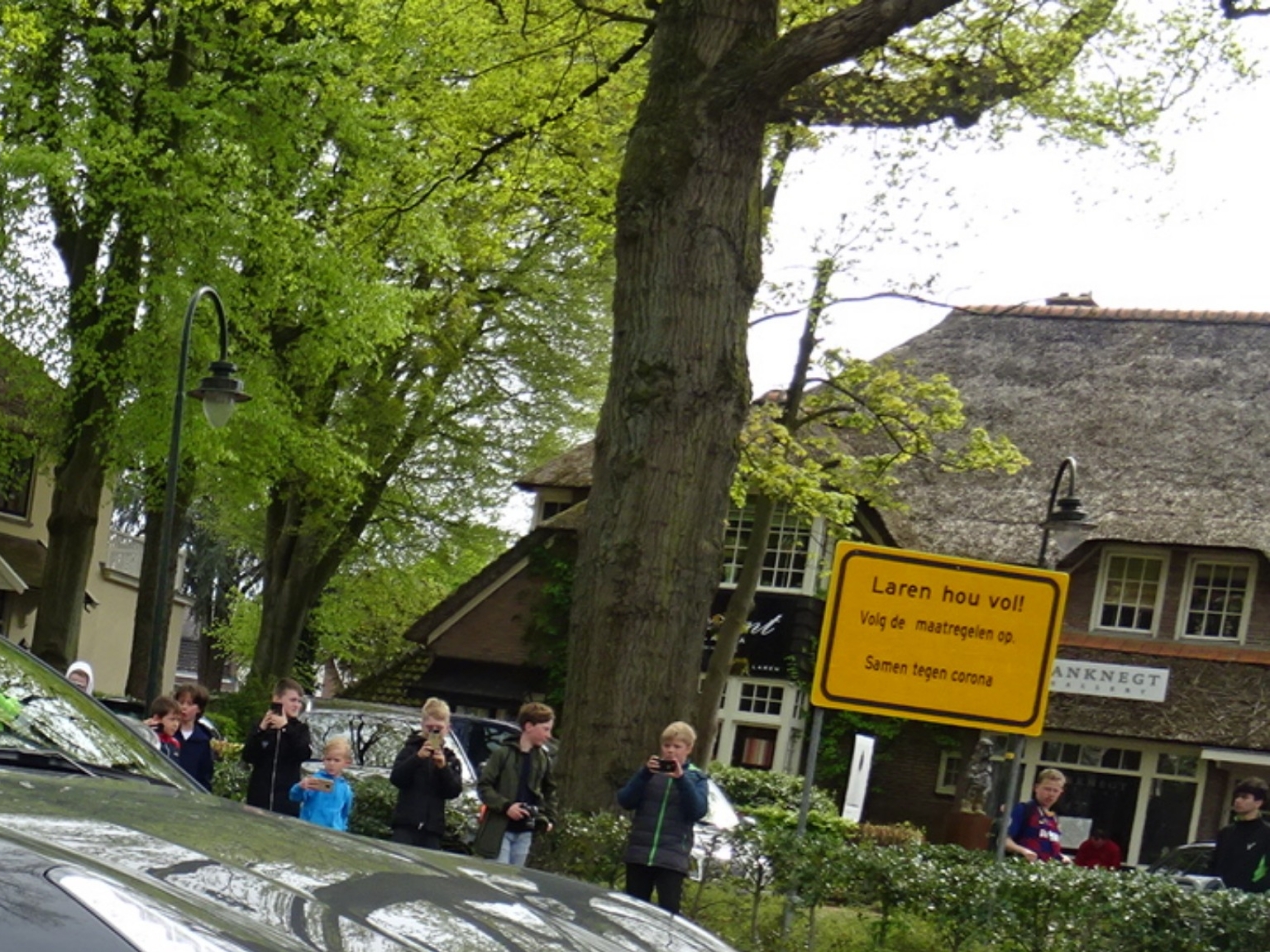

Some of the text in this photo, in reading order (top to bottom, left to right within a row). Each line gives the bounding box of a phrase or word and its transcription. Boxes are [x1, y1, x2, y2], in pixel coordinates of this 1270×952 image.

[872, 576, 1025, 612] Laren hou vol!
[860, 611, 1015, 645] Volg de maatregelen op.
[865, 654, 993, 687] Samen tegen corona
[1051, 666, 1161, 687] ANKNEGT
